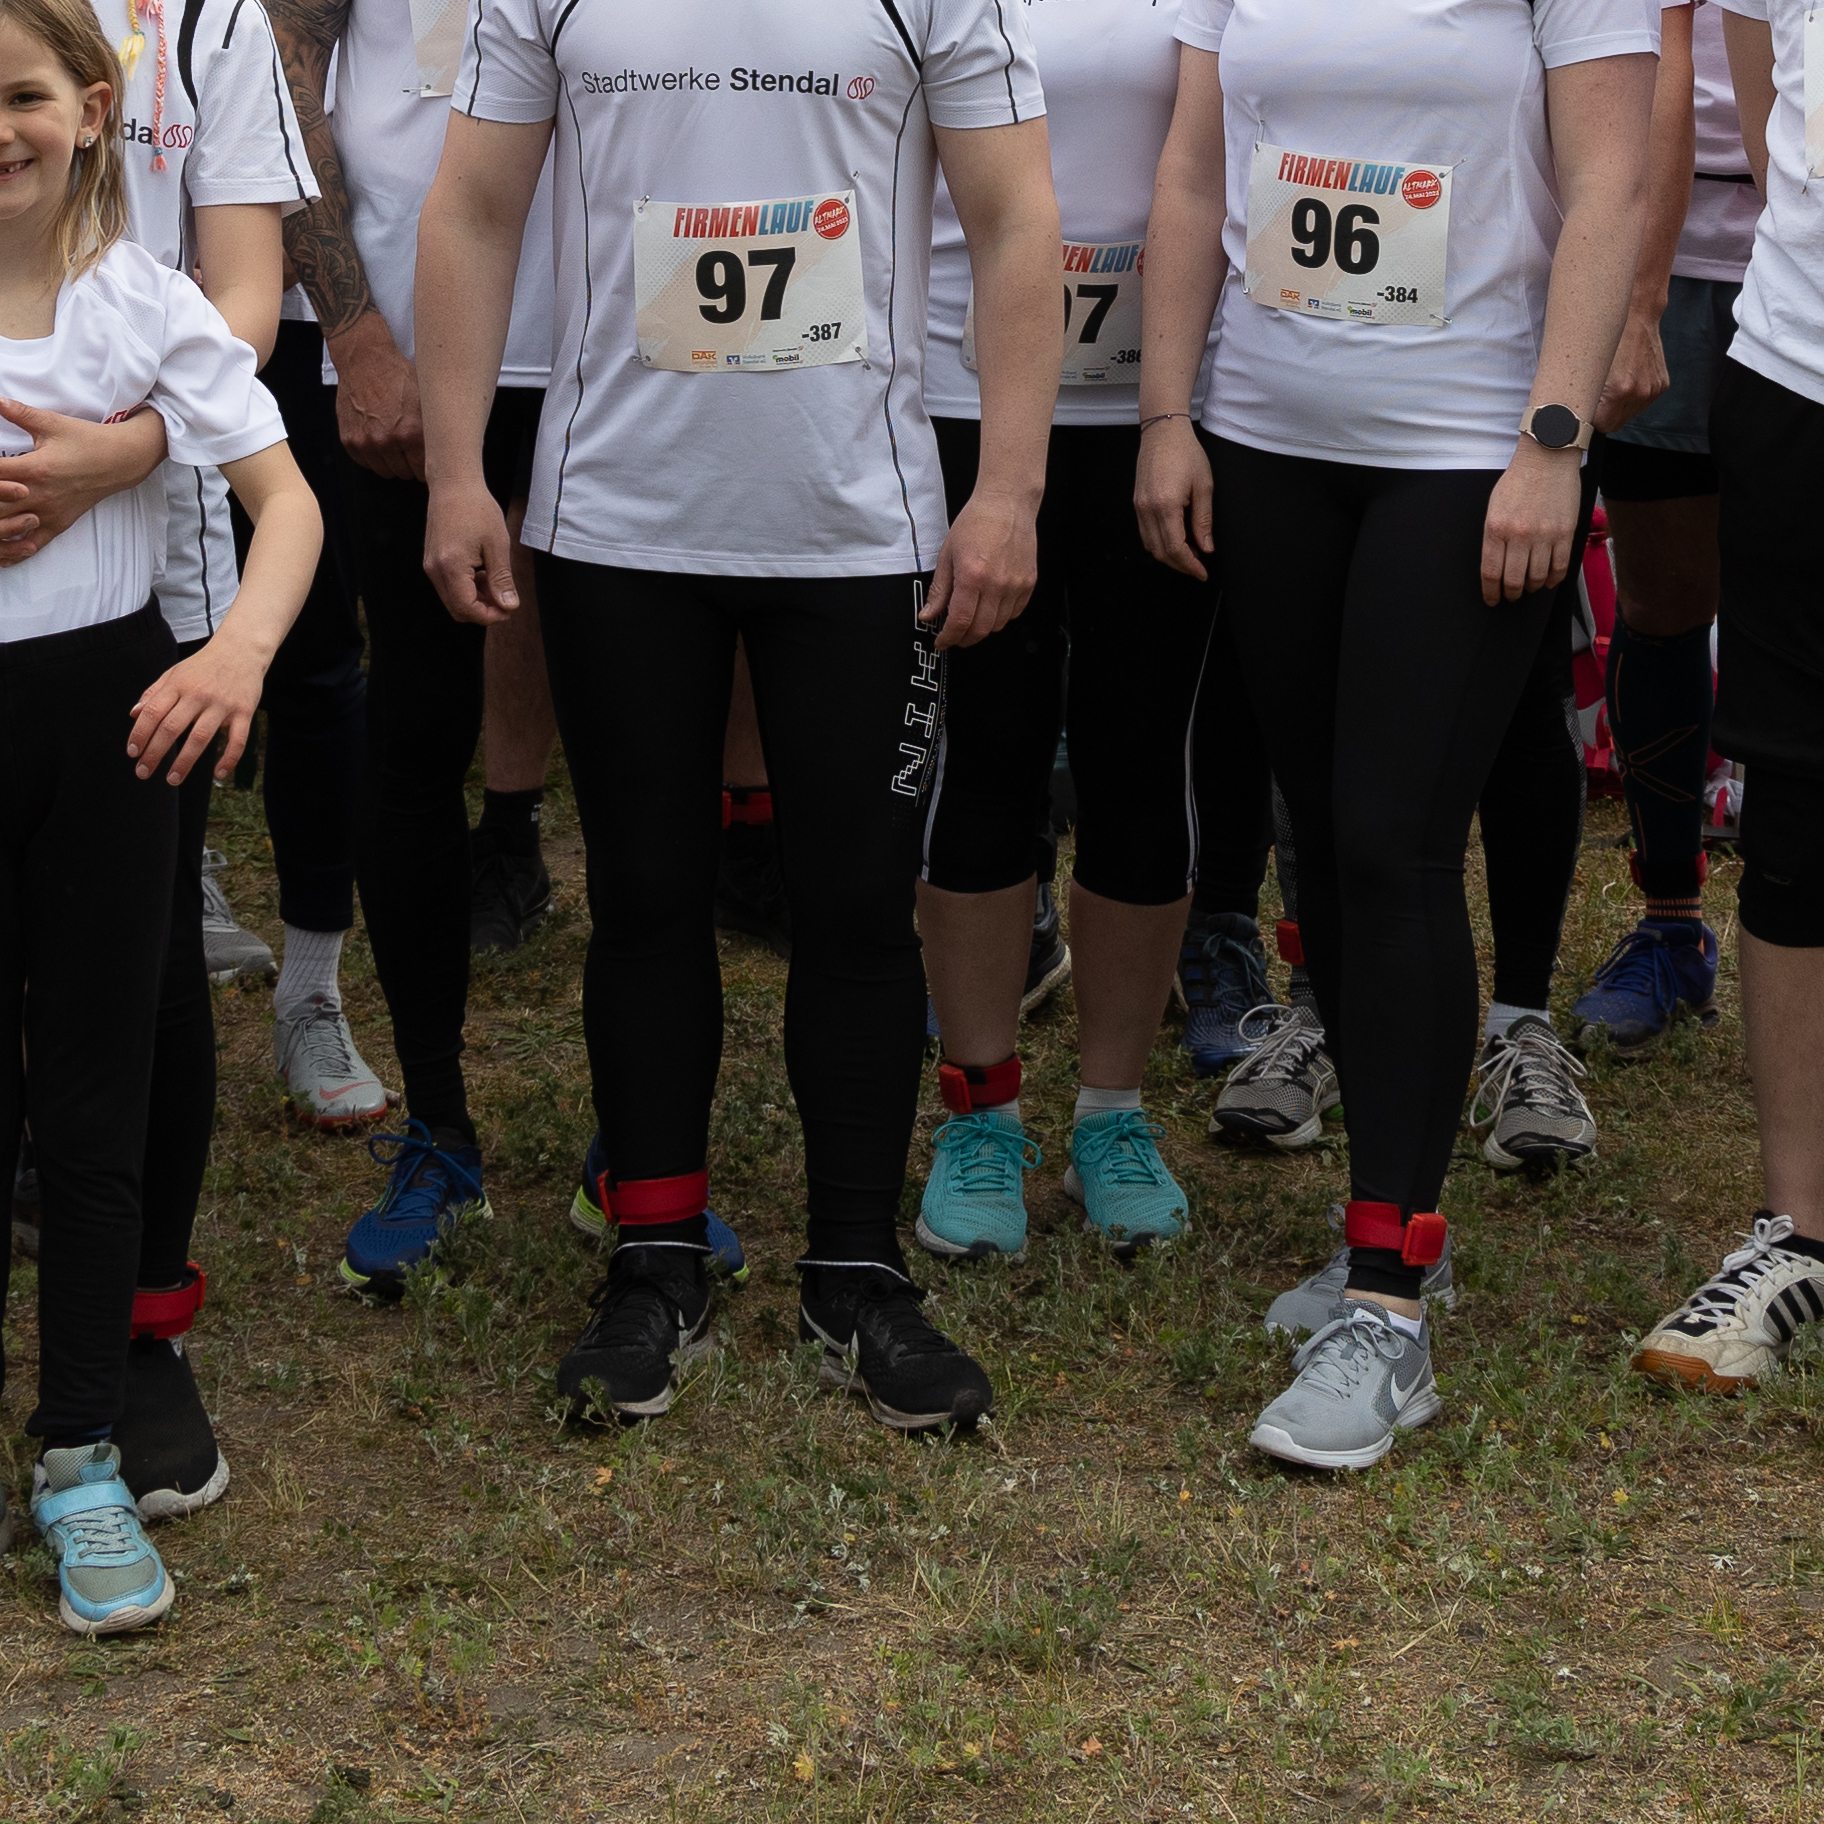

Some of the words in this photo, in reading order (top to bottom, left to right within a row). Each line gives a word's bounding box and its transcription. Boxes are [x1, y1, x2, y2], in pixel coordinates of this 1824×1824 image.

[581, 66, 721, 95] Stadtwerke
[729, 66, 839, 97] Stendal
[1278, 152, 1406, 196] FIRMENLAUF
[673, 200, 814, 239] FIRMENLAUF
[1290, 197, 1381, 276] 96
[695, 246, 796, 325] 97
[1376, 285, 1419, 304] -384
[801, 321, 843, 343] -387
[1064, 283, 1119, 344] 7
[691, 351, 717, 361] DAK
